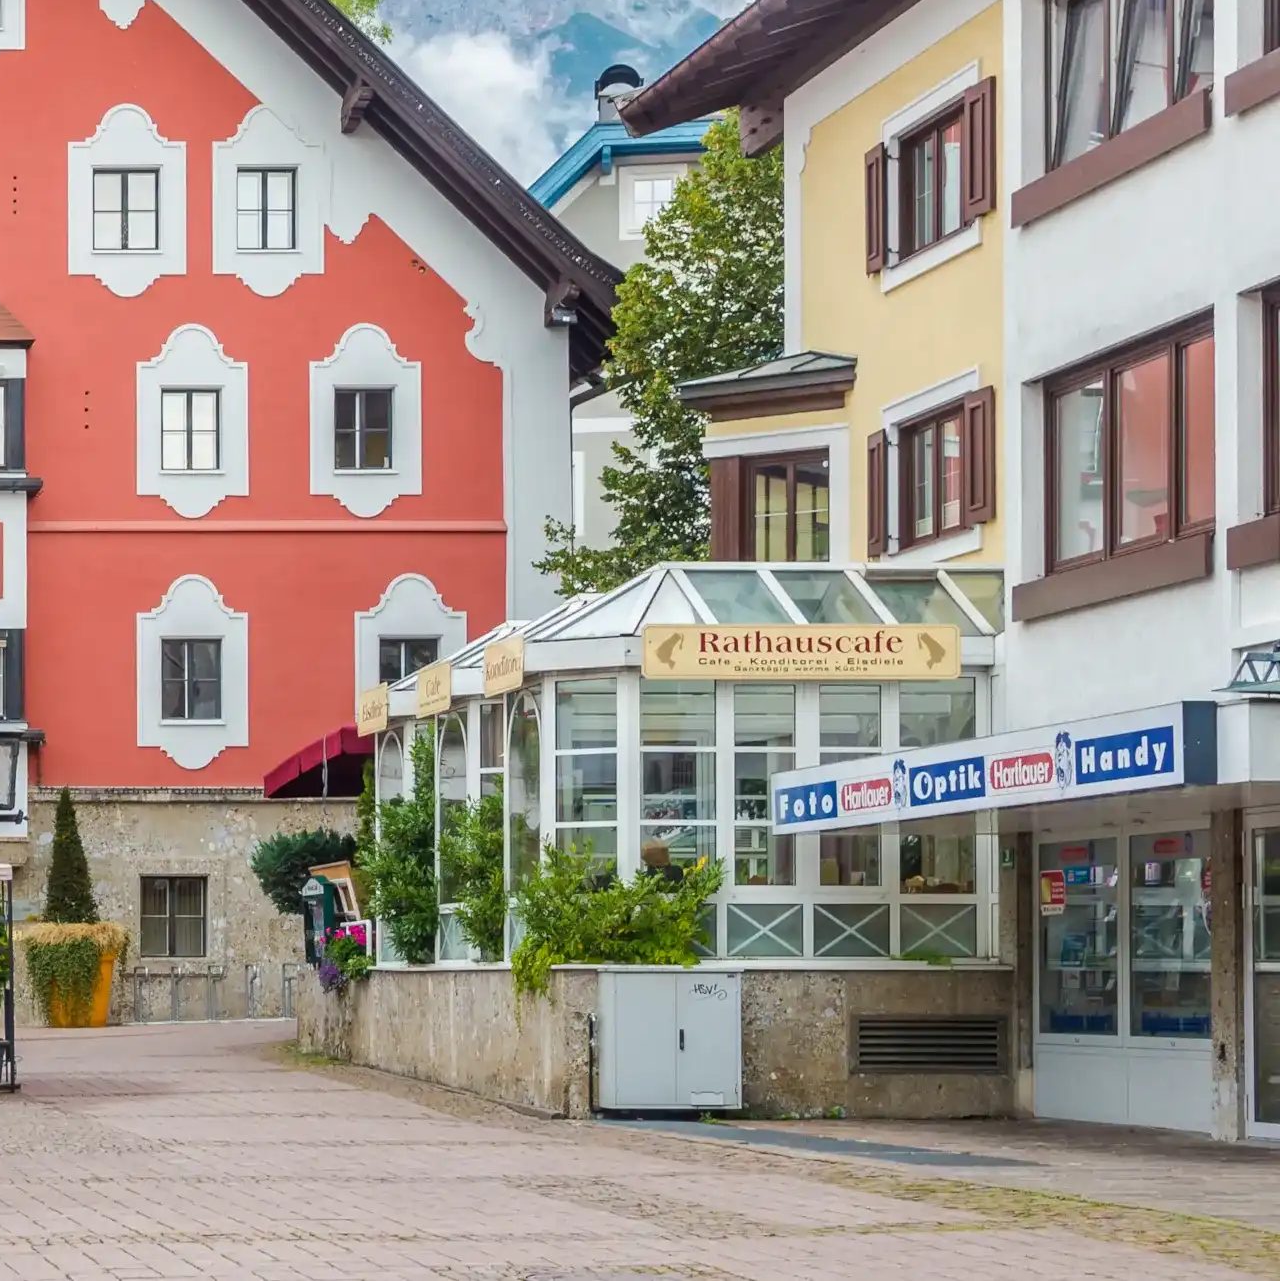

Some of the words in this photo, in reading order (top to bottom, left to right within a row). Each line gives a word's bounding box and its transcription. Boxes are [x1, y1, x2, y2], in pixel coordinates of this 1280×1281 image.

[699, 630, 904, 653] Rathauscafe
[698, 658, 731, 666] Cafe
[749, 658, 827, 666] Konditorei
[847, 658, 904, 666] Eisdiele
[1080, 736, 1167, 773] Handy
[912, 764, 981, 801] Optik
[993, 754, 1051, 789] Hartlauer
[779, 791, 834, 819] Foto
[842, 779, 891, 812] Hartlauer
